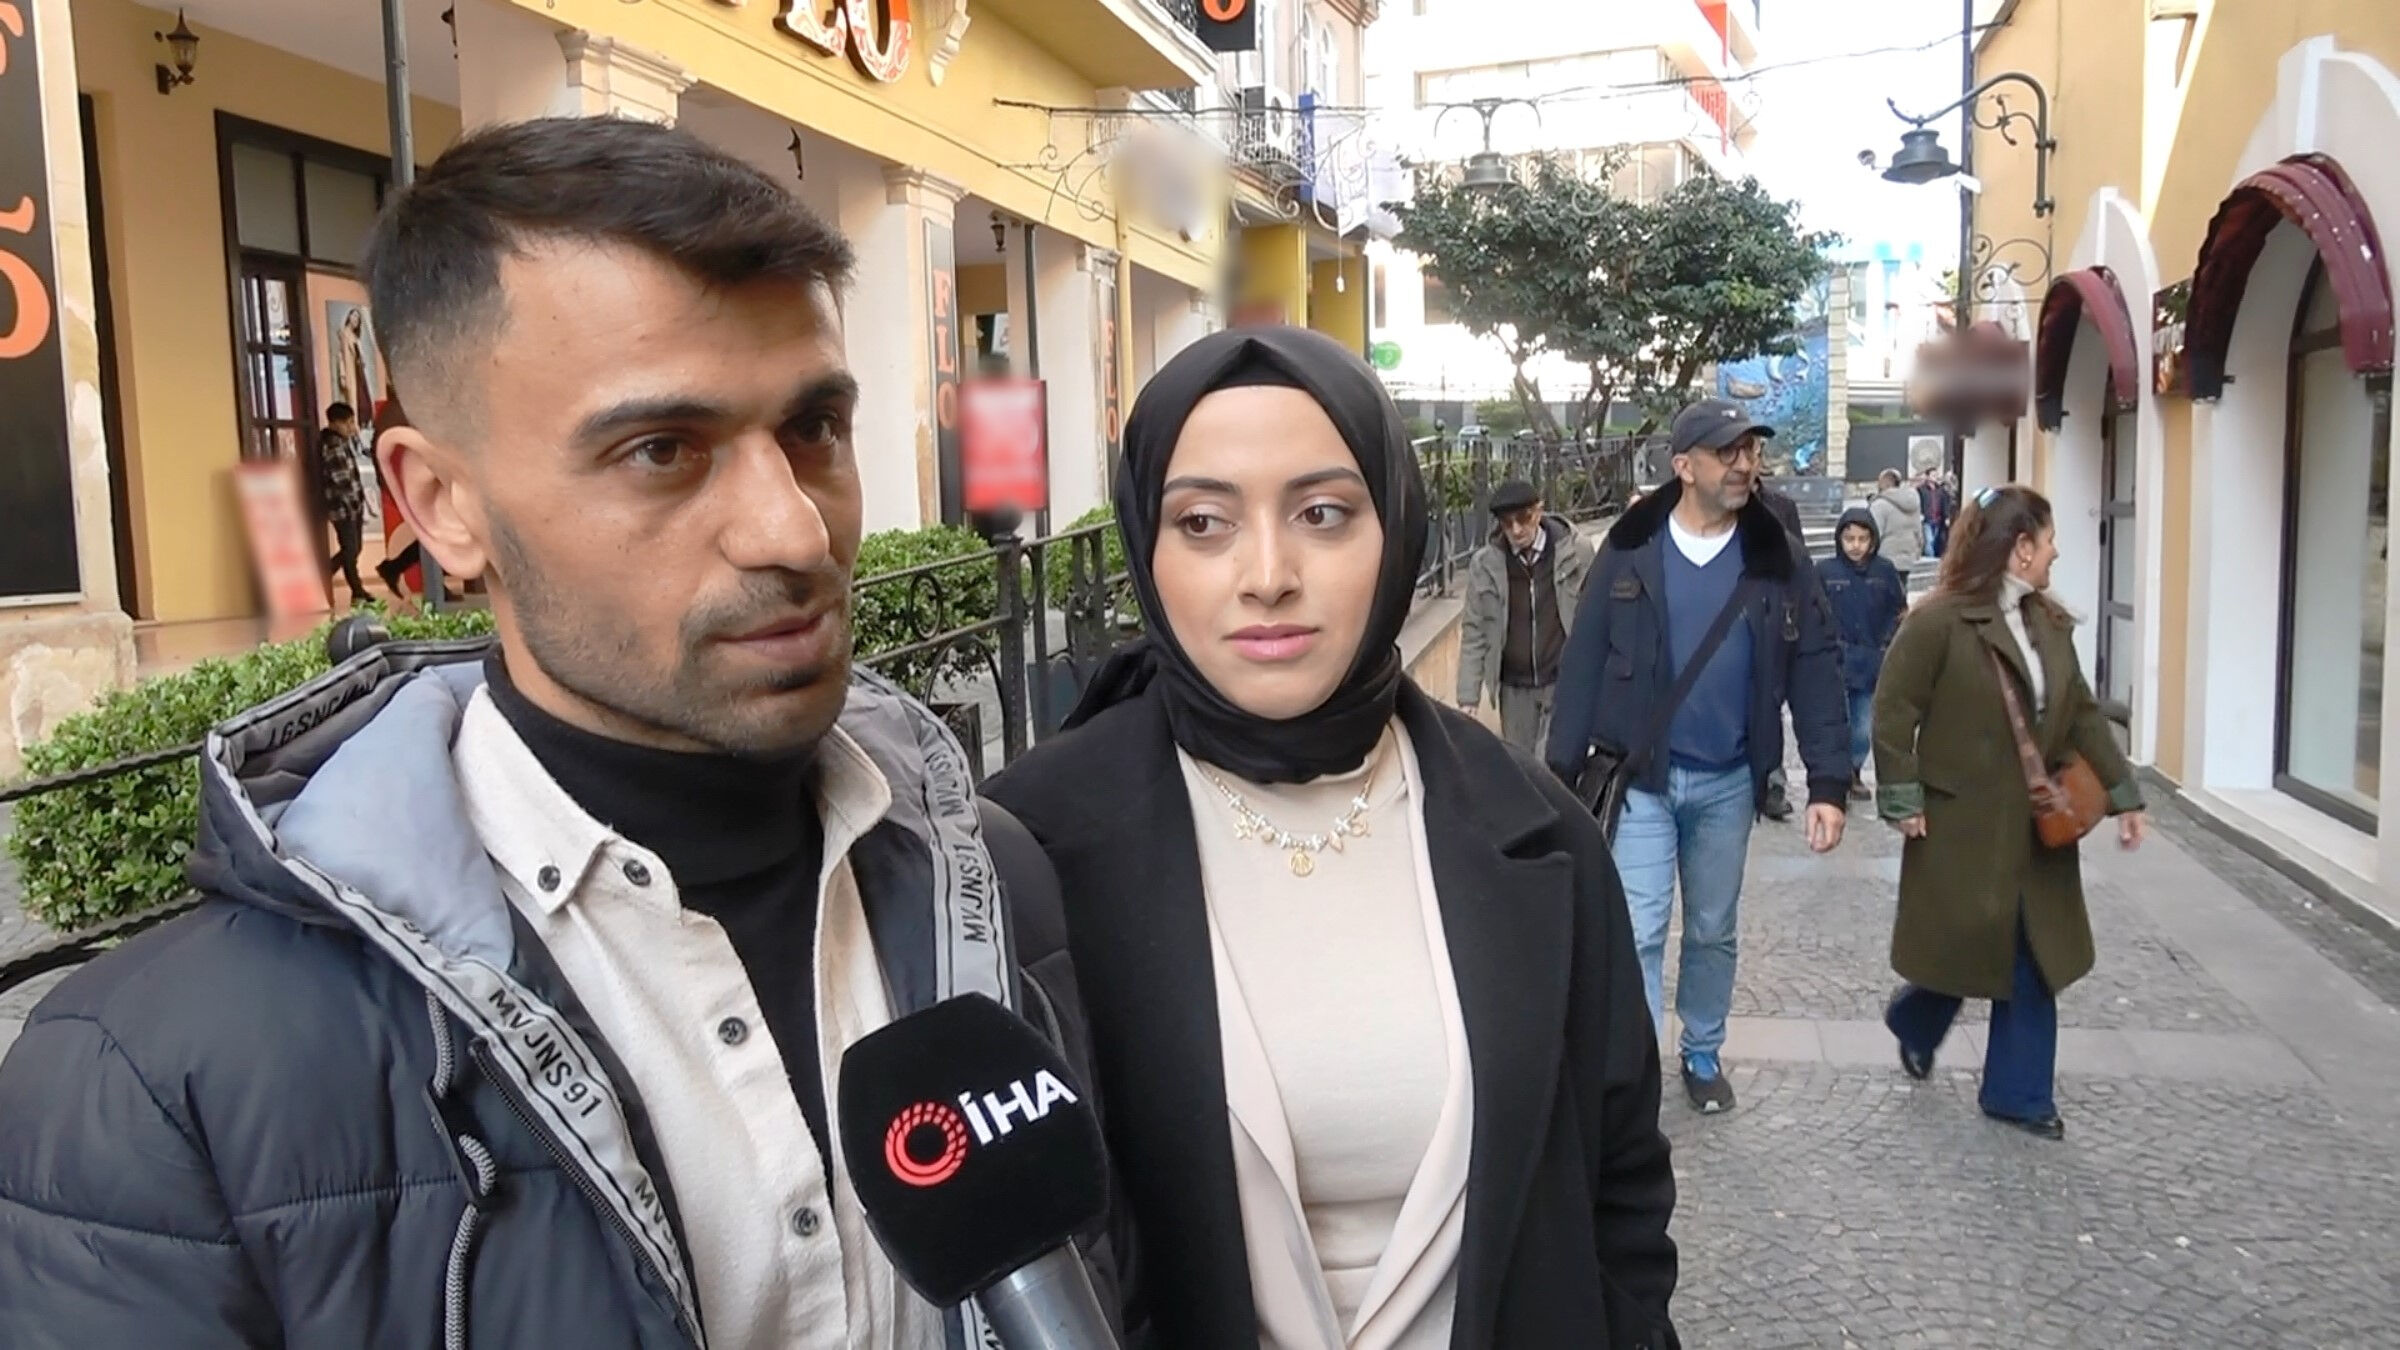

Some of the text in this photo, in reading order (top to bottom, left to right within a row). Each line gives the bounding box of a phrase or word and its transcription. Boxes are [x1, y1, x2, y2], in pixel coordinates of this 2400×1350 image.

[933, 270, 957, 430] FLO
[488, 988, 603, 1117] MVJNS91
[958, 1069, 1078, 1145] İHA
